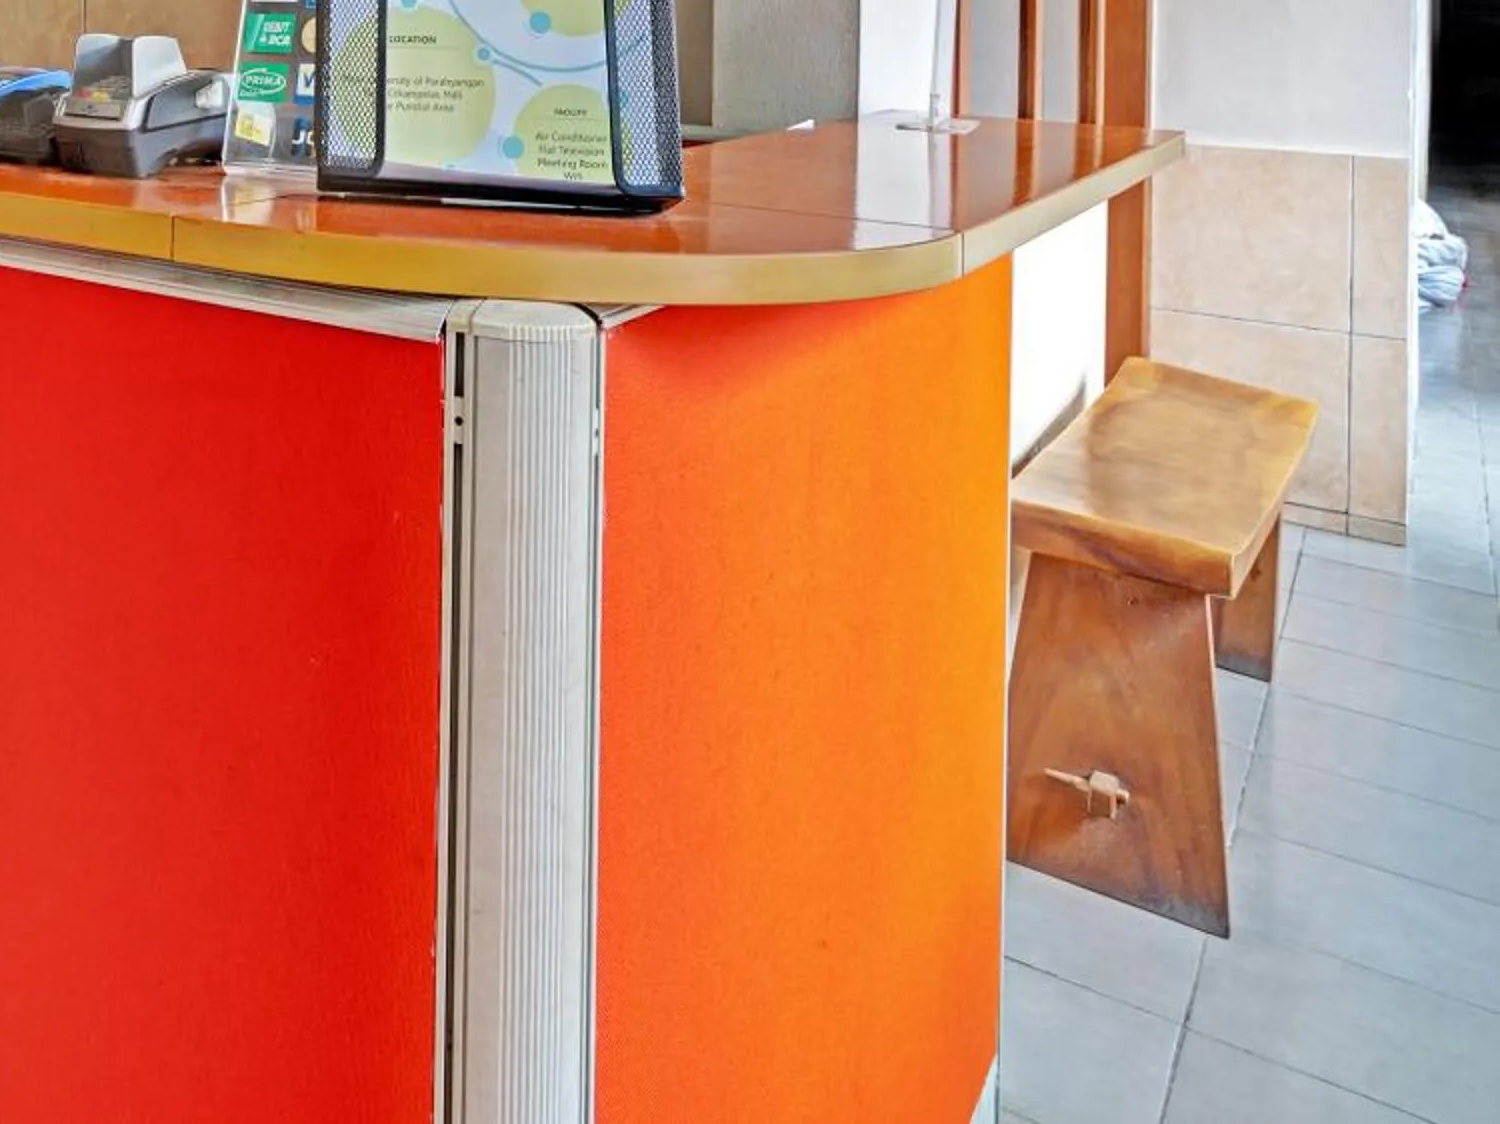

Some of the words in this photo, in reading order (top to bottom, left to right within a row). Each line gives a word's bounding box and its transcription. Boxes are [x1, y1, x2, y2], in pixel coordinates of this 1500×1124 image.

[245, 75, 282, 85] PRIMA
[535, 131, 549, 141] Air
[558, 145, 605, 157] Television
[536, 157, 577, 170] Meeting
[579, 158, 608, 169] Room
